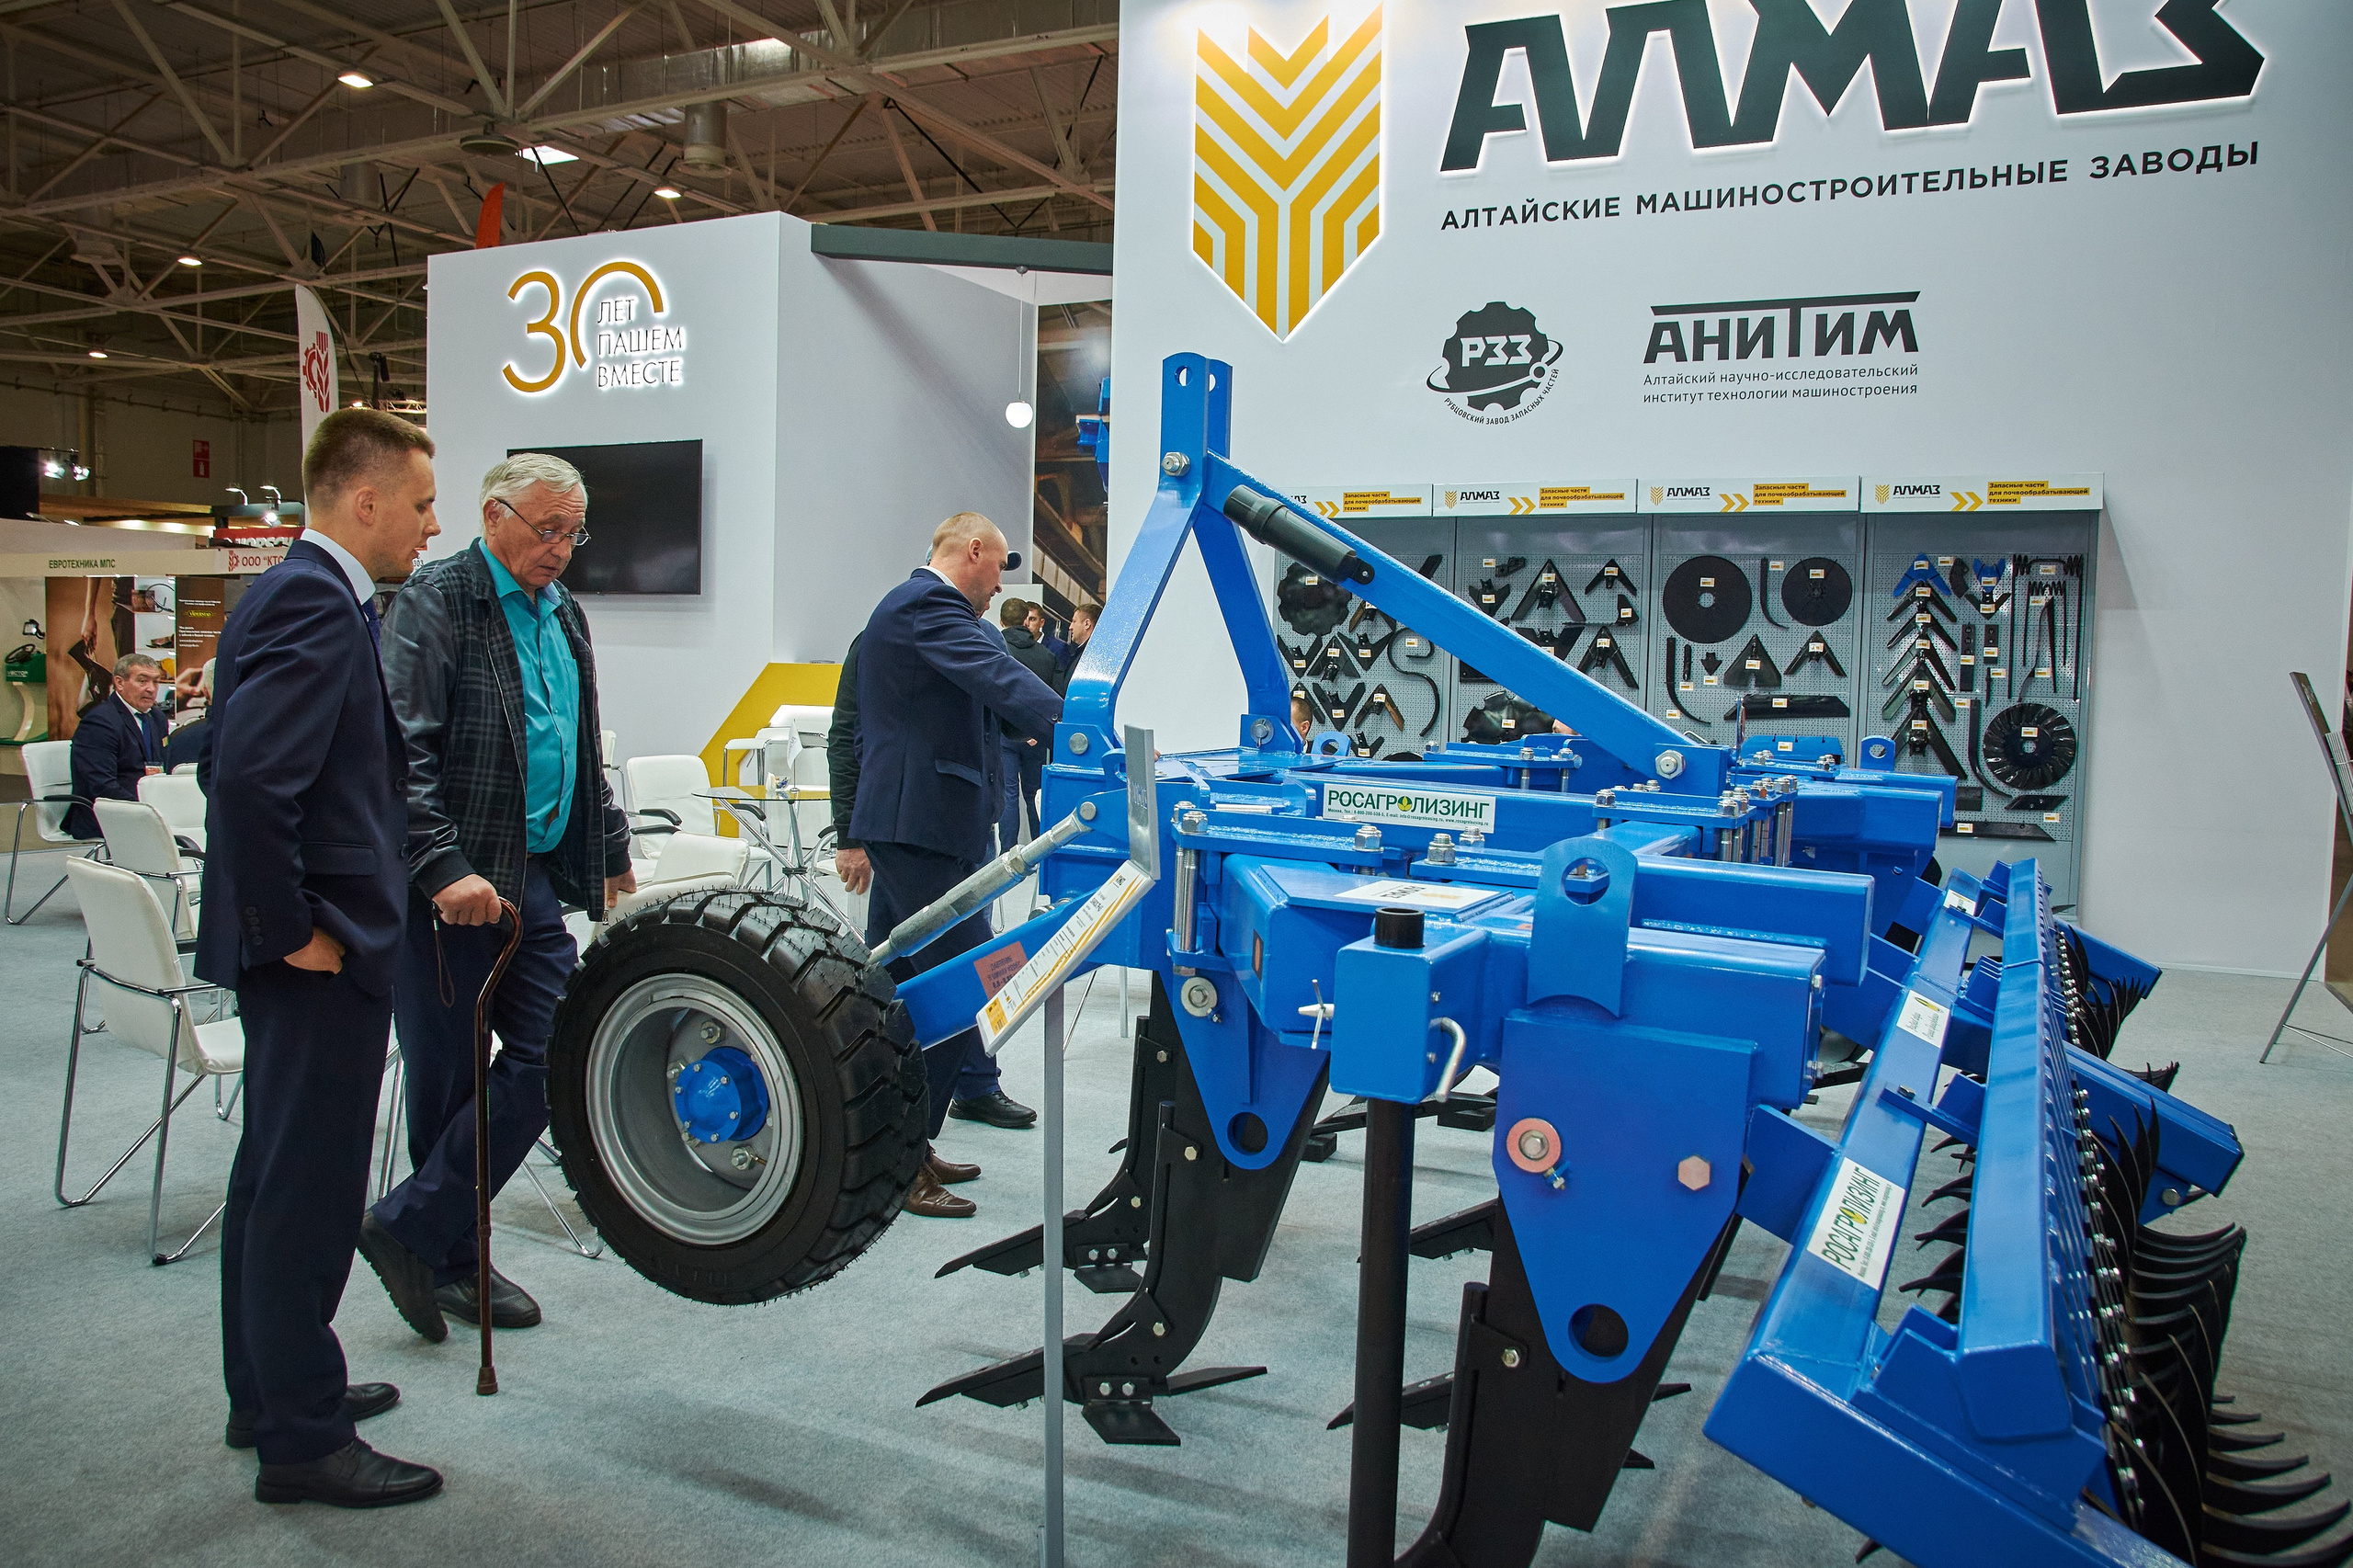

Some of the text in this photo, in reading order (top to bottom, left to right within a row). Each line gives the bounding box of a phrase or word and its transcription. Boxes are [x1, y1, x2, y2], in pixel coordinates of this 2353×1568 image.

[1440, 0, 2266, 172] АЛМАЗ
[1441, 142, 2258, 230] АЛТАЙСКИЕ МАШИНОСТРОИТЕЛЬНЫЕ ЗАВОДЫ
[597, 299, 634, 324] ЛЕТ
[503, 261, 664, 392] 30
[598, 327, 682, 356] ПАШЕМ
[598, 360, 680, 387] ВМЕСТЕ
[1643, 364, 1917, 385] Алтайский научно-исследовательский
[1444, 369, 1560, 426] РУБЦОВСКИЙ ЗАВОД ЗАПАСНЫХ ЧАСТЕЙ
[1643, 384, 1917, 404] институт технологии машиностроения
[1460, 490, 1500, 501] АЛМАЗ
[1552, 493, 1623, 501] почвообрабатывающей
[1666, 486, 1711, 497] АЛМАЗ
[1767, 490, 1845, 498] почвообрабатывающей
[1893, 484, 1940, 495] АЛМАЗ
[2003, 488, 2088, 496] почвообрабатывающей
[1355, 497, 1421, 506] почвообрабатывающей
[49, 559, 116, 569] ЕВРОТЕХНИКА МПС
[242, 556, 261, 566] ООО
[1328, 790, 1490, 819] РОСАГРОЛИЗИНГ
[1821, 1165, 1881, 1271] РОСАГРОЛИЗИНГ
